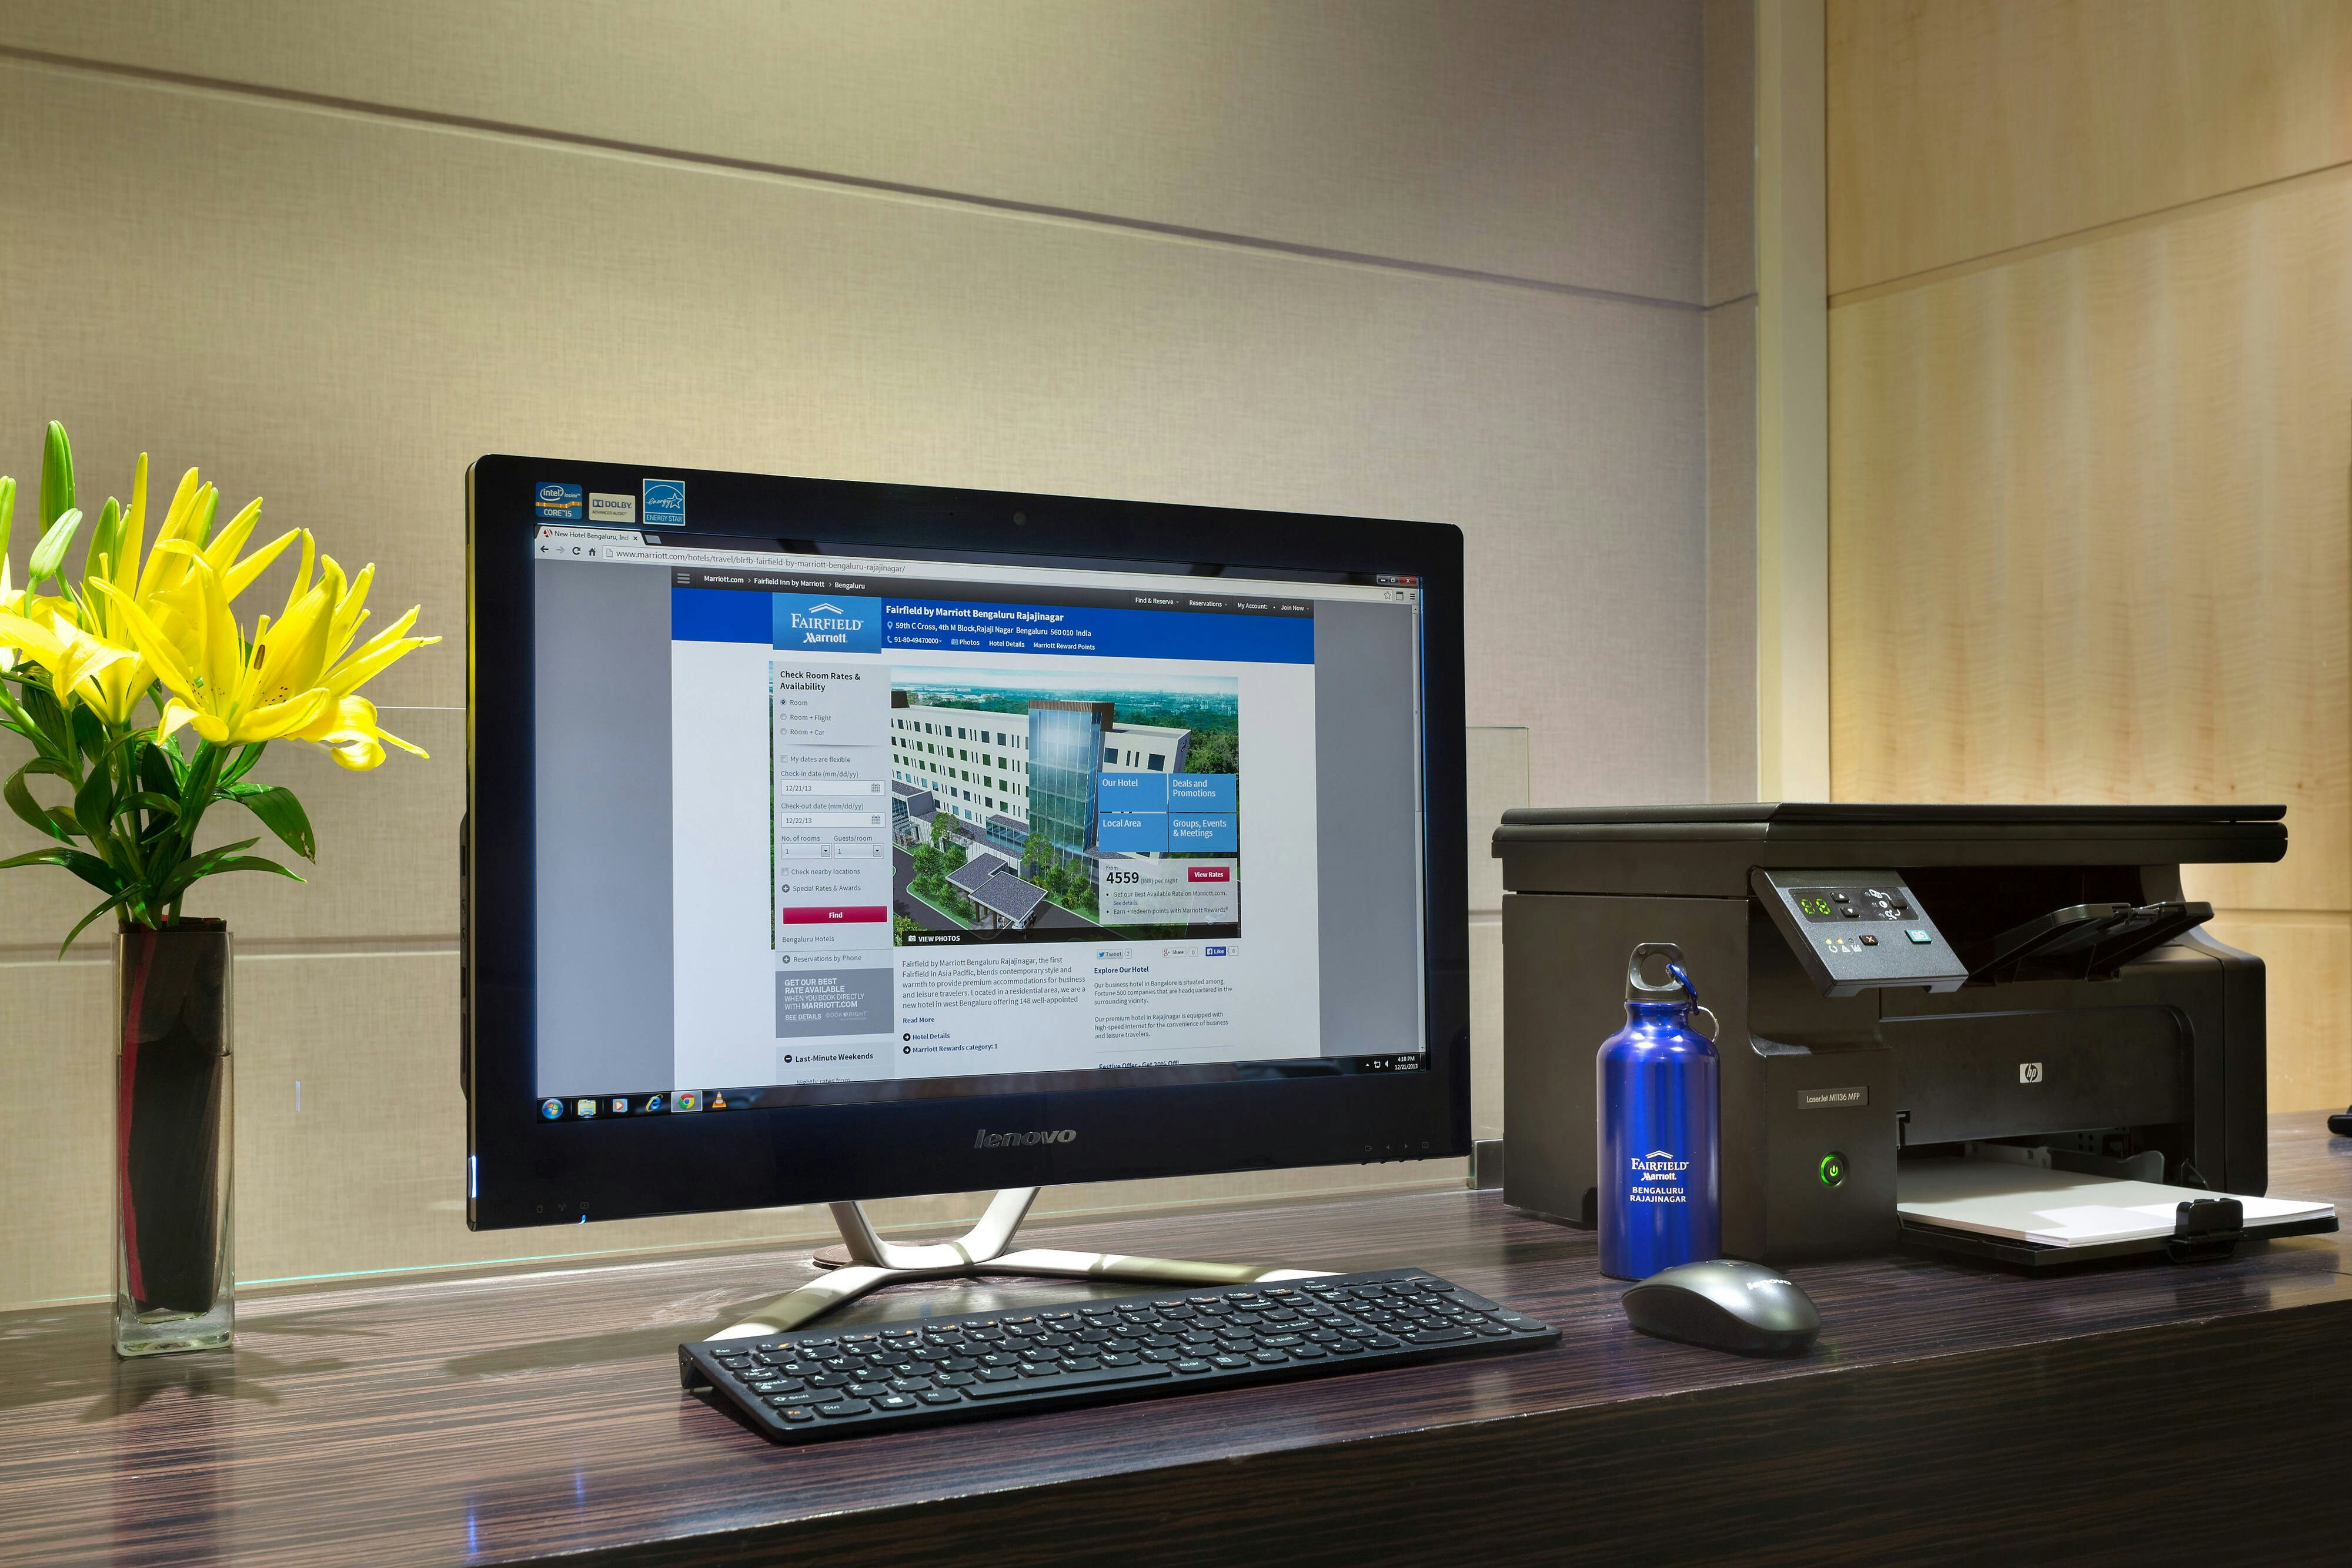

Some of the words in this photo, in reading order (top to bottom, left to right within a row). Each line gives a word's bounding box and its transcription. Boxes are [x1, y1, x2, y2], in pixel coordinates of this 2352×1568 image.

[543, 488, 563, 497] intel
[704, 575, 744, 584] Marriott.com
[886, 606, 922, 614] Fairfield
[924, 607, 934, 617] by
[936, 608, 971, 617] Marriott
[973, 610, 1014, 619] Bengaluru
[1017, 612, 1063, 622] Rajajinagar
[917, 623, 937, 631] Cross,
[957, 624, 993, 633] Block,Rajaji
[995, 626, 1013, 634] Nagar
[1016, 627, 1047, 635] Bengaluru
[803, 632, 847, 643] Marriott
[780, 683, 825, 692] Availability
[1173, 819, 1201, 828] Groups,
[1180, 829, 1212, 838] Meetings
[1106, 872, 1139, 884] 4559
[2027, 1063, 2036, 1083] hp
[1807, 1095, 1828, 1103] LaserJet
[974, 1129, 1077, 1148] lenovo
[1641, 1172, 1676, 1181] Marriott
